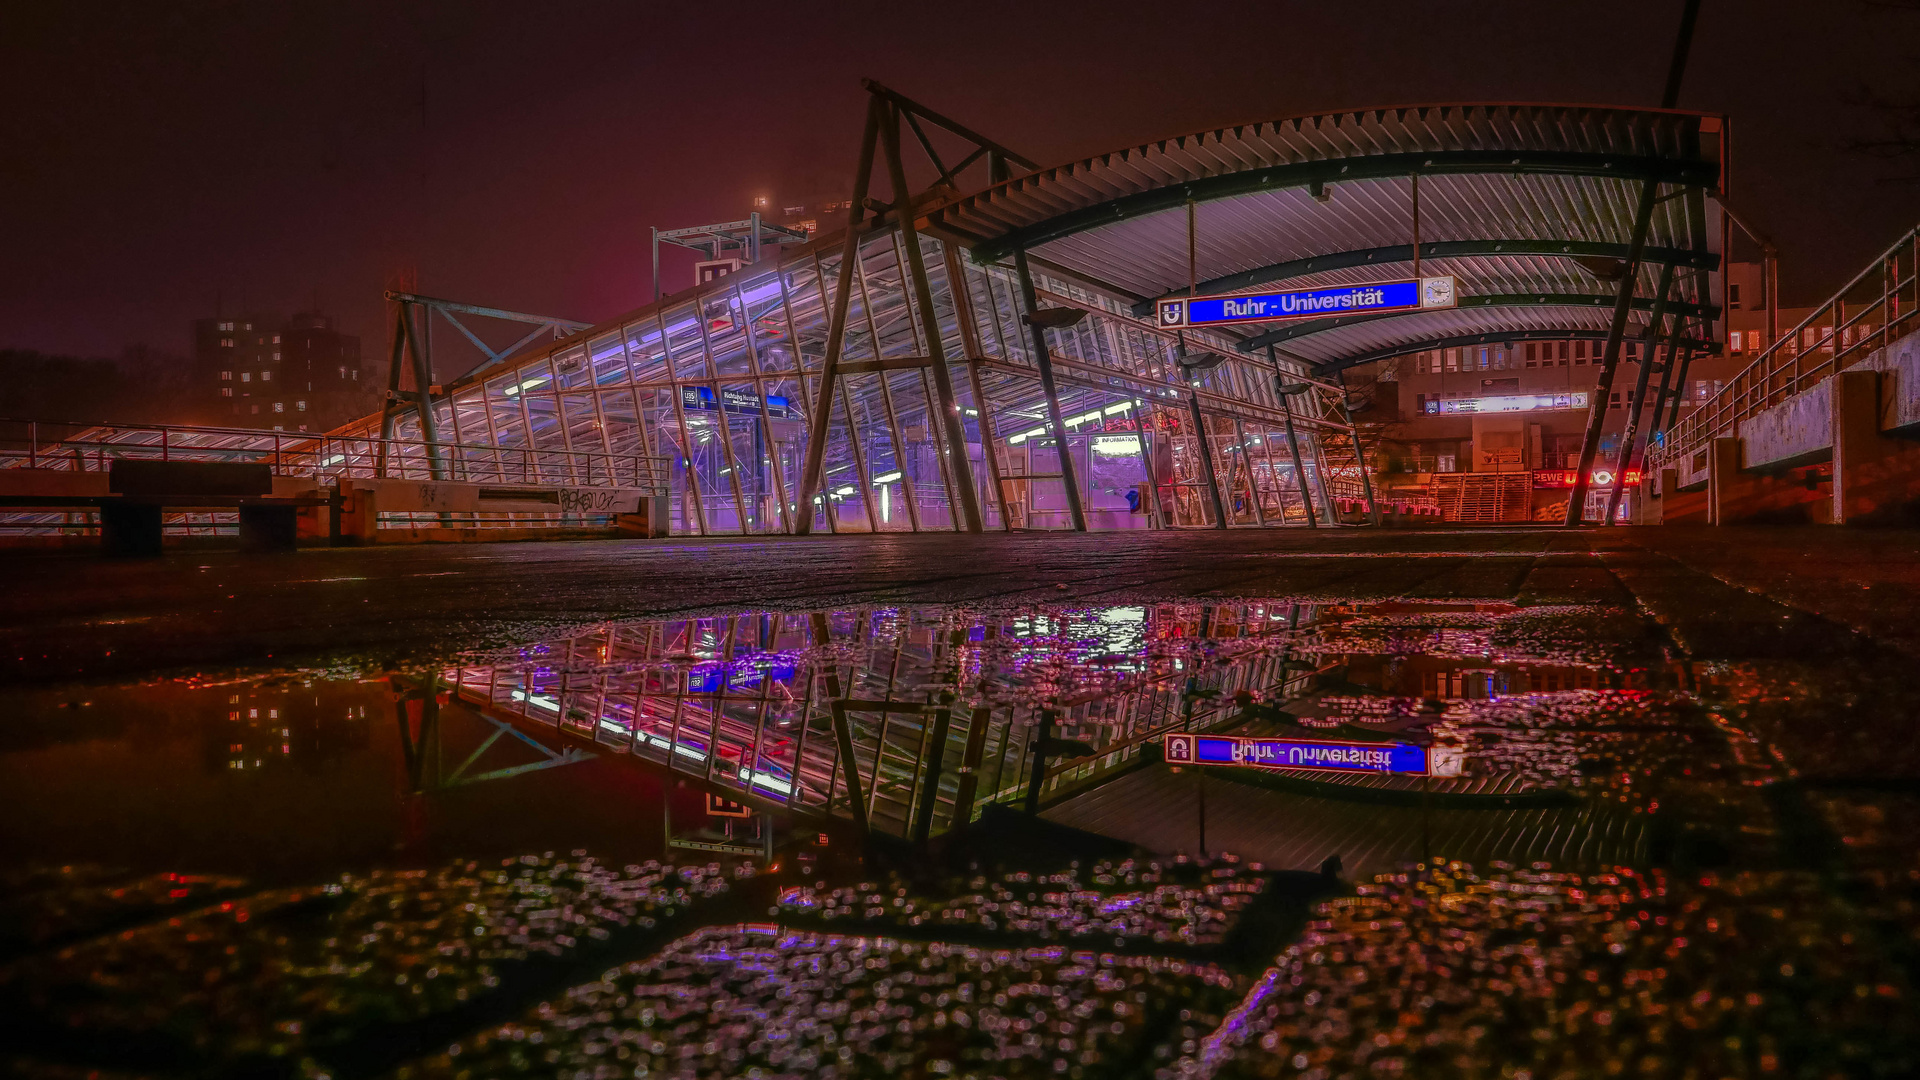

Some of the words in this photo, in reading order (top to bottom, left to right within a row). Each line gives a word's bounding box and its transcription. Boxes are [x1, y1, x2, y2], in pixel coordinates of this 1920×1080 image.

[1223, 299, 1267, 317] Ruhr
[1281, 288, 1385, 312] Universität
[1533, 472, 1563, 482] REWE
